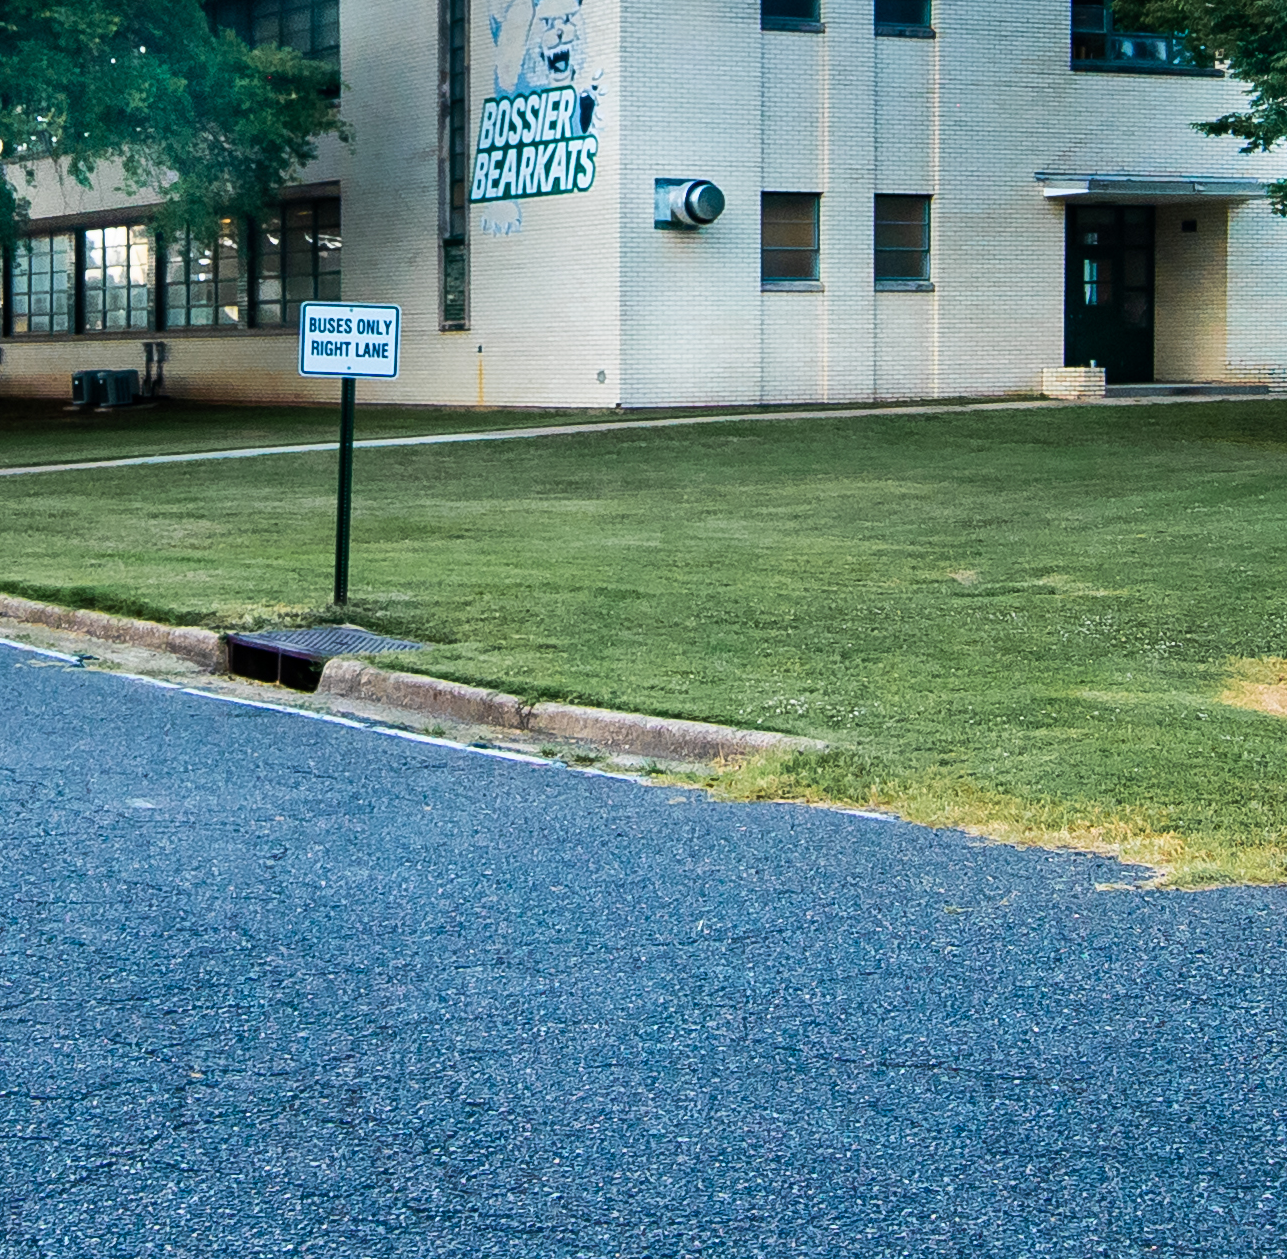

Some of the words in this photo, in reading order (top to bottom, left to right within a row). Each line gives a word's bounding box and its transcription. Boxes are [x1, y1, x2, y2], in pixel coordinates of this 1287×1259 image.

[479, 87, 577, 150] BOSSIER
[472, 137, 598, 201] BEARKATS
[309, 317, 353, 335] BUSES
[357, 318, 393, 336] ONLY
[311, 340, 352, 358] RIGHT
[355, 342, 389, 359] LANE
